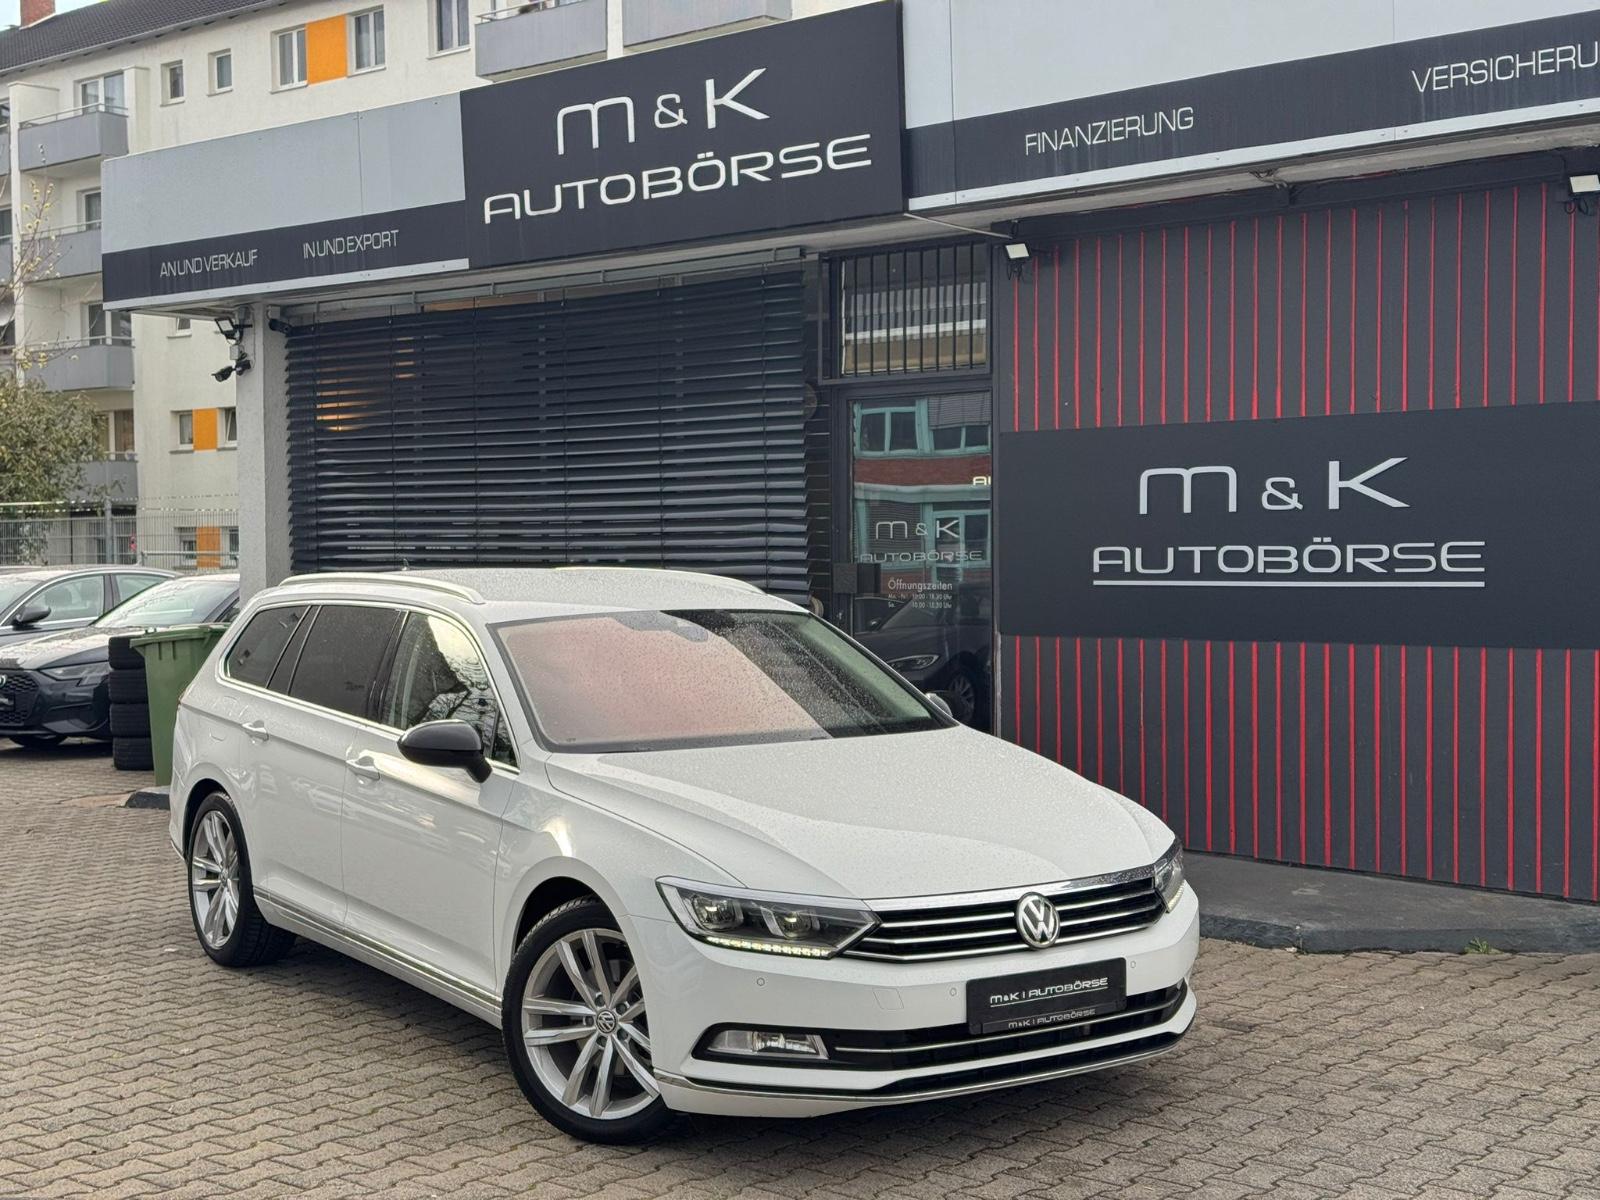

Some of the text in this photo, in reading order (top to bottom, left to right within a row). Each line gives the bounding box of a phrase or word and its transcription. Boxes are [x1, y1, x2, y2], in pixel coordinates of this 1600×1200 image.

[1411, 40, 1599, 93] VERSICHERU
[654, 93, 688, 129] &
[705, 67, 770, 129] K
[1025, 106, 1195, 156] FINANZIERUNG
[484, 133, 872, 224] AUTOBÖRSE
[303, 229, 400, 259] IN UND EXPORT
[160, 249, 259, 278] AN UND VERKAUF
[1261, 476, 1304, 511] &
[1328, 456, 1411, 510] K
[915, 522, 928, 536] &
[936, 519, 960, 539] K
[1093, 536, 1486, 574] AUTOBÖRSE
[888, 576, 953, 593] Öffnungszeiten
[1028, 977, 1109, 998] AUTOBÖRSE
